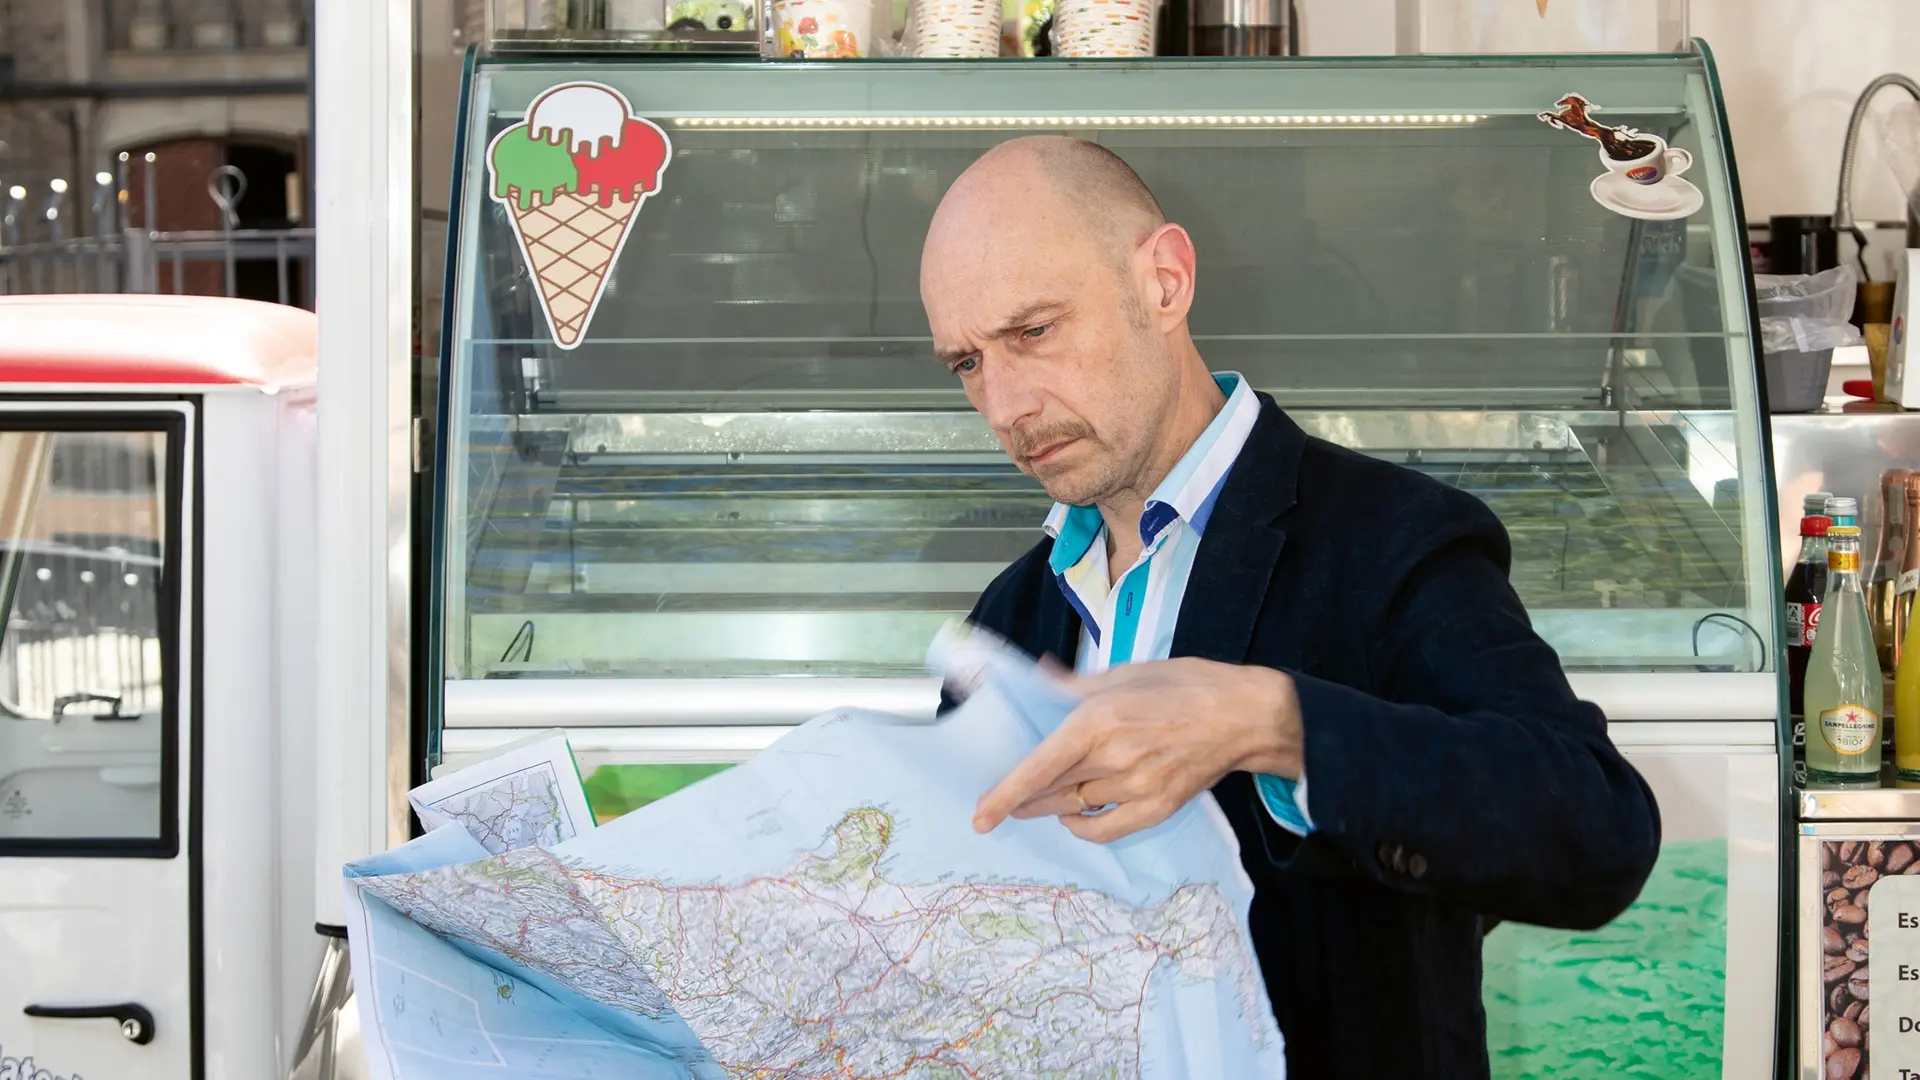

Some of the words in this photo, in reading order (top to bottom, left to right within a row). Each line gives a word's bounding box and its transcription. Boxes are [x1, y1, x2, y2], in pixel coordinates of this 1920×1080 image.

[1824, 720, 1875, 729] SANPELLEGRINO
[1898, 912, 1919, 929] Es
[1898, 964, 1920, 981] Es
